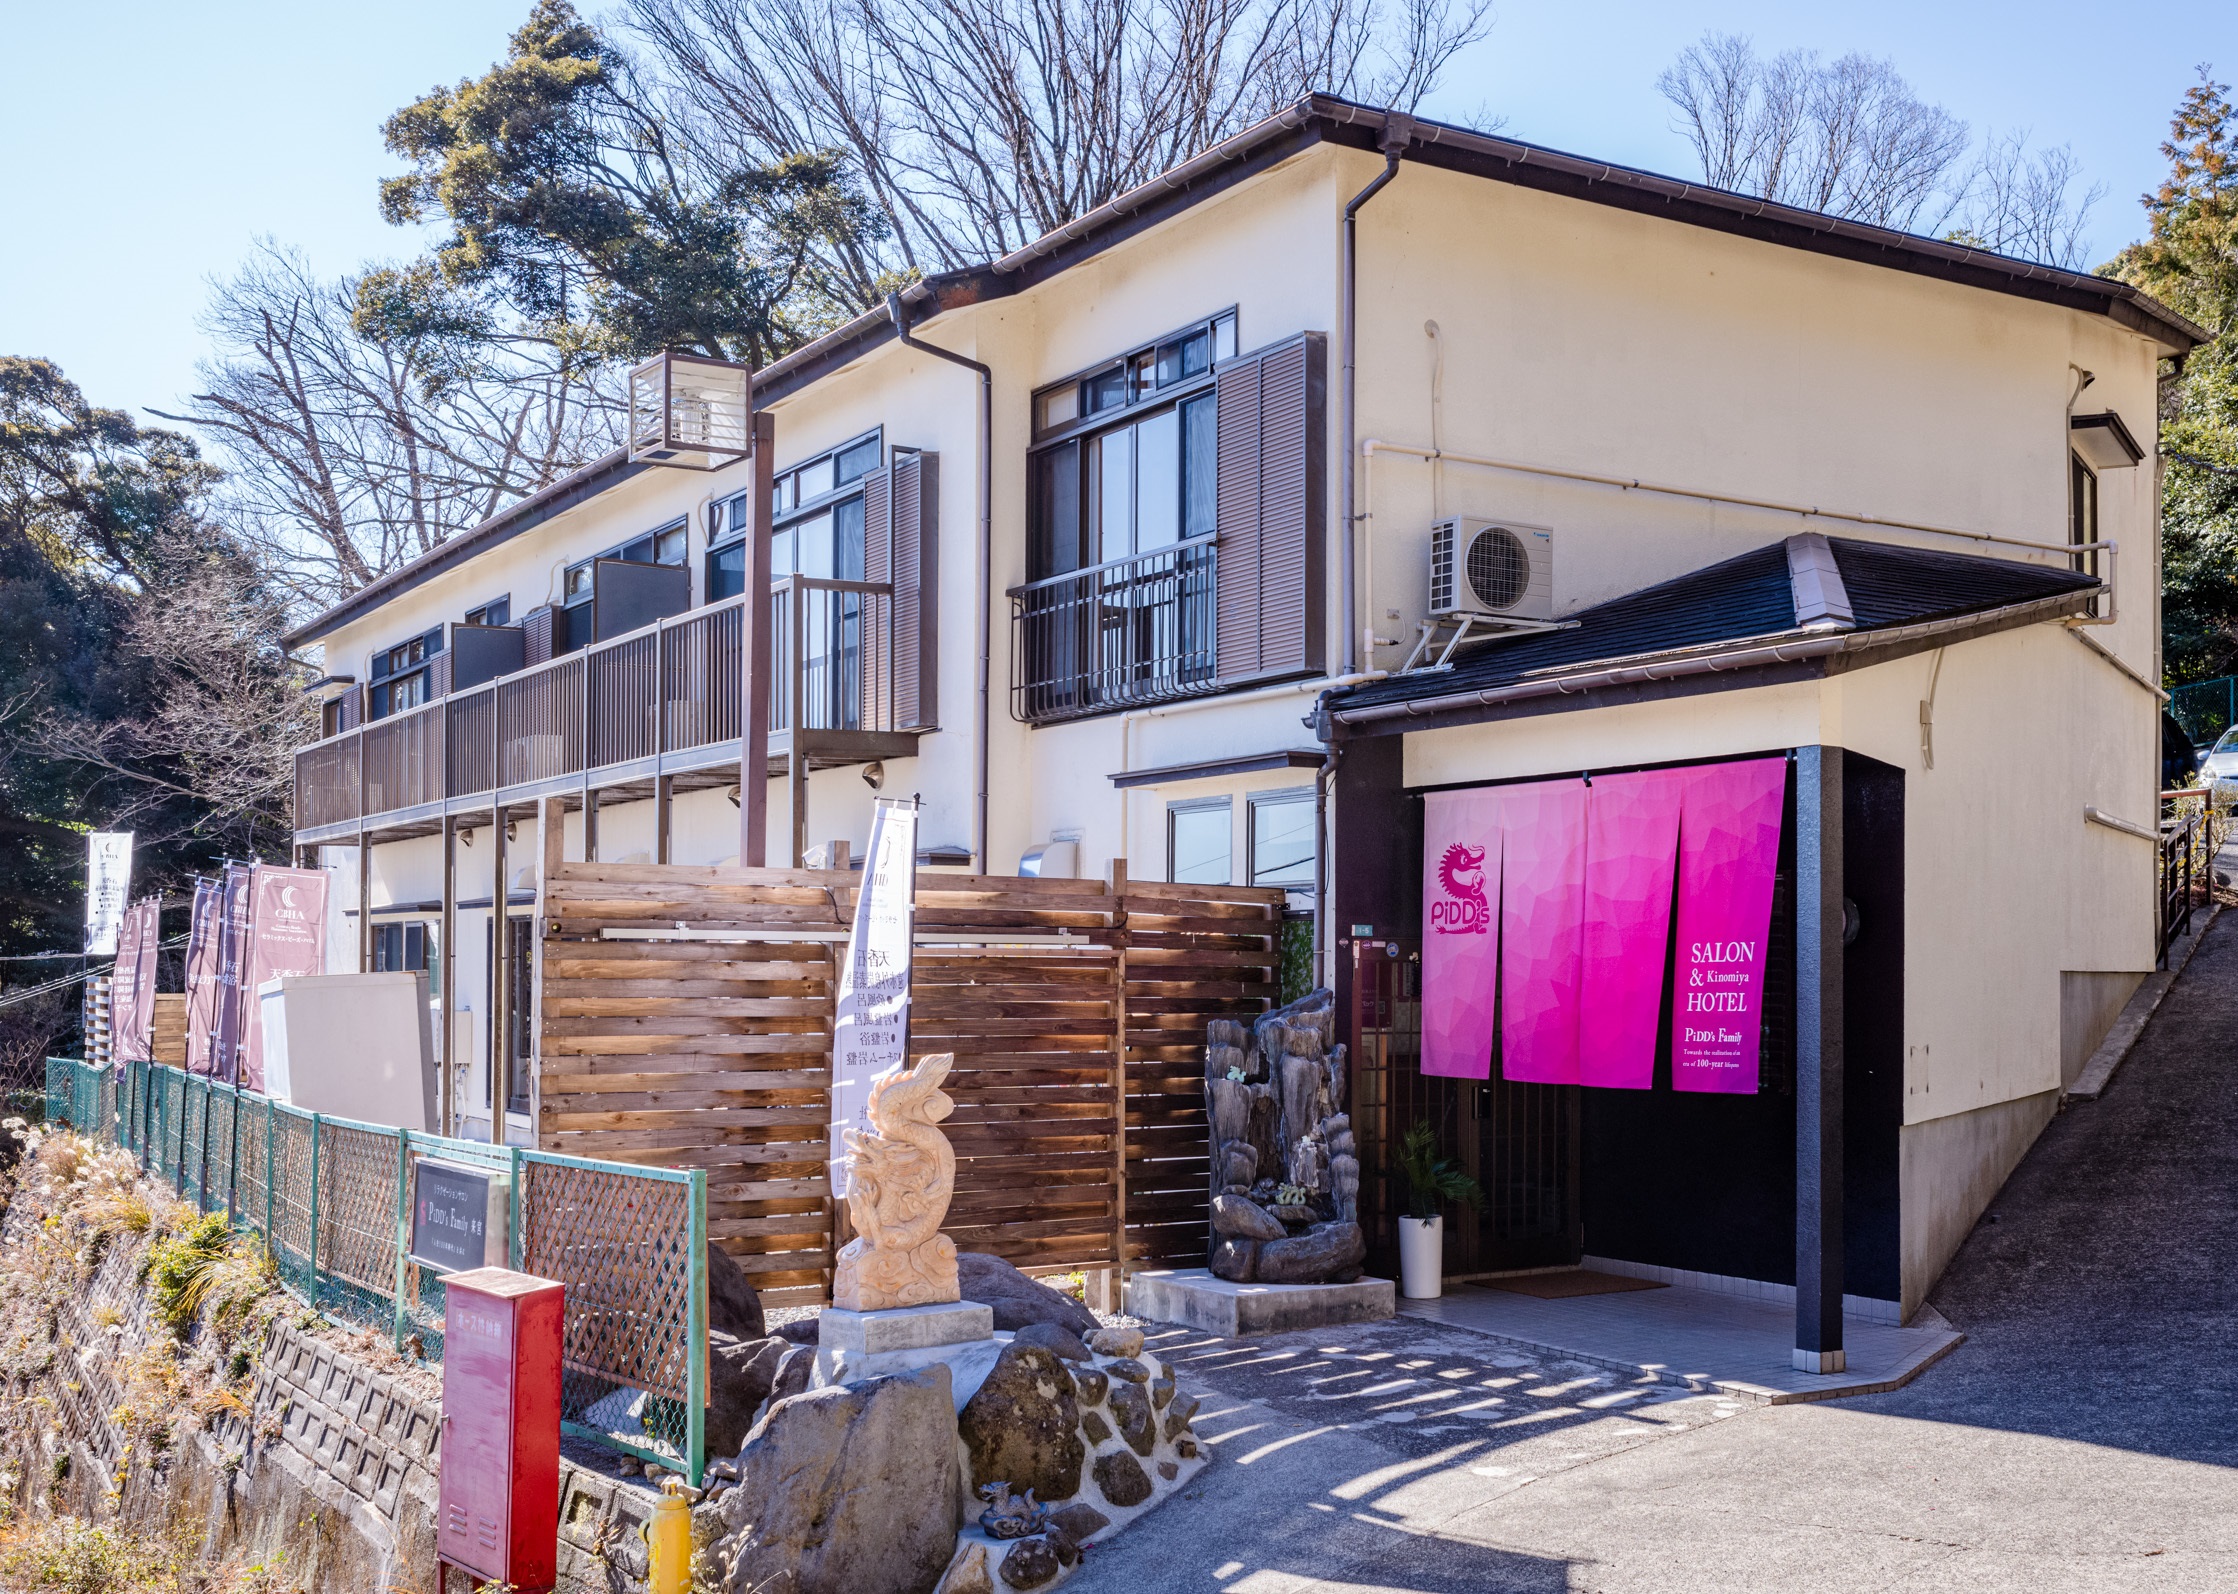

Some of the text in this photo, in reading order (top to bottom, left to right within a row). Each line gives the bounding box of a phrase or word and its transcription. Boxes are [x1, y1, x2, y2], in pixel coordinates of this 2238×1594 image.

[275, 909, 305, 920] CBHA
[1691, 942, 1755, 963] SALON
[1689, 968, 1749, 986] & Kinomiya
[1686, 992, 1747, 1012] HOTEL
[1684, 1027, 1742, 1045] PiDD's Family
[1697, 1058, 1723, 1070] 100-year
[428, 1202, 449, 1226] PiDD's
[450, 1208, 469, 1236] Family
